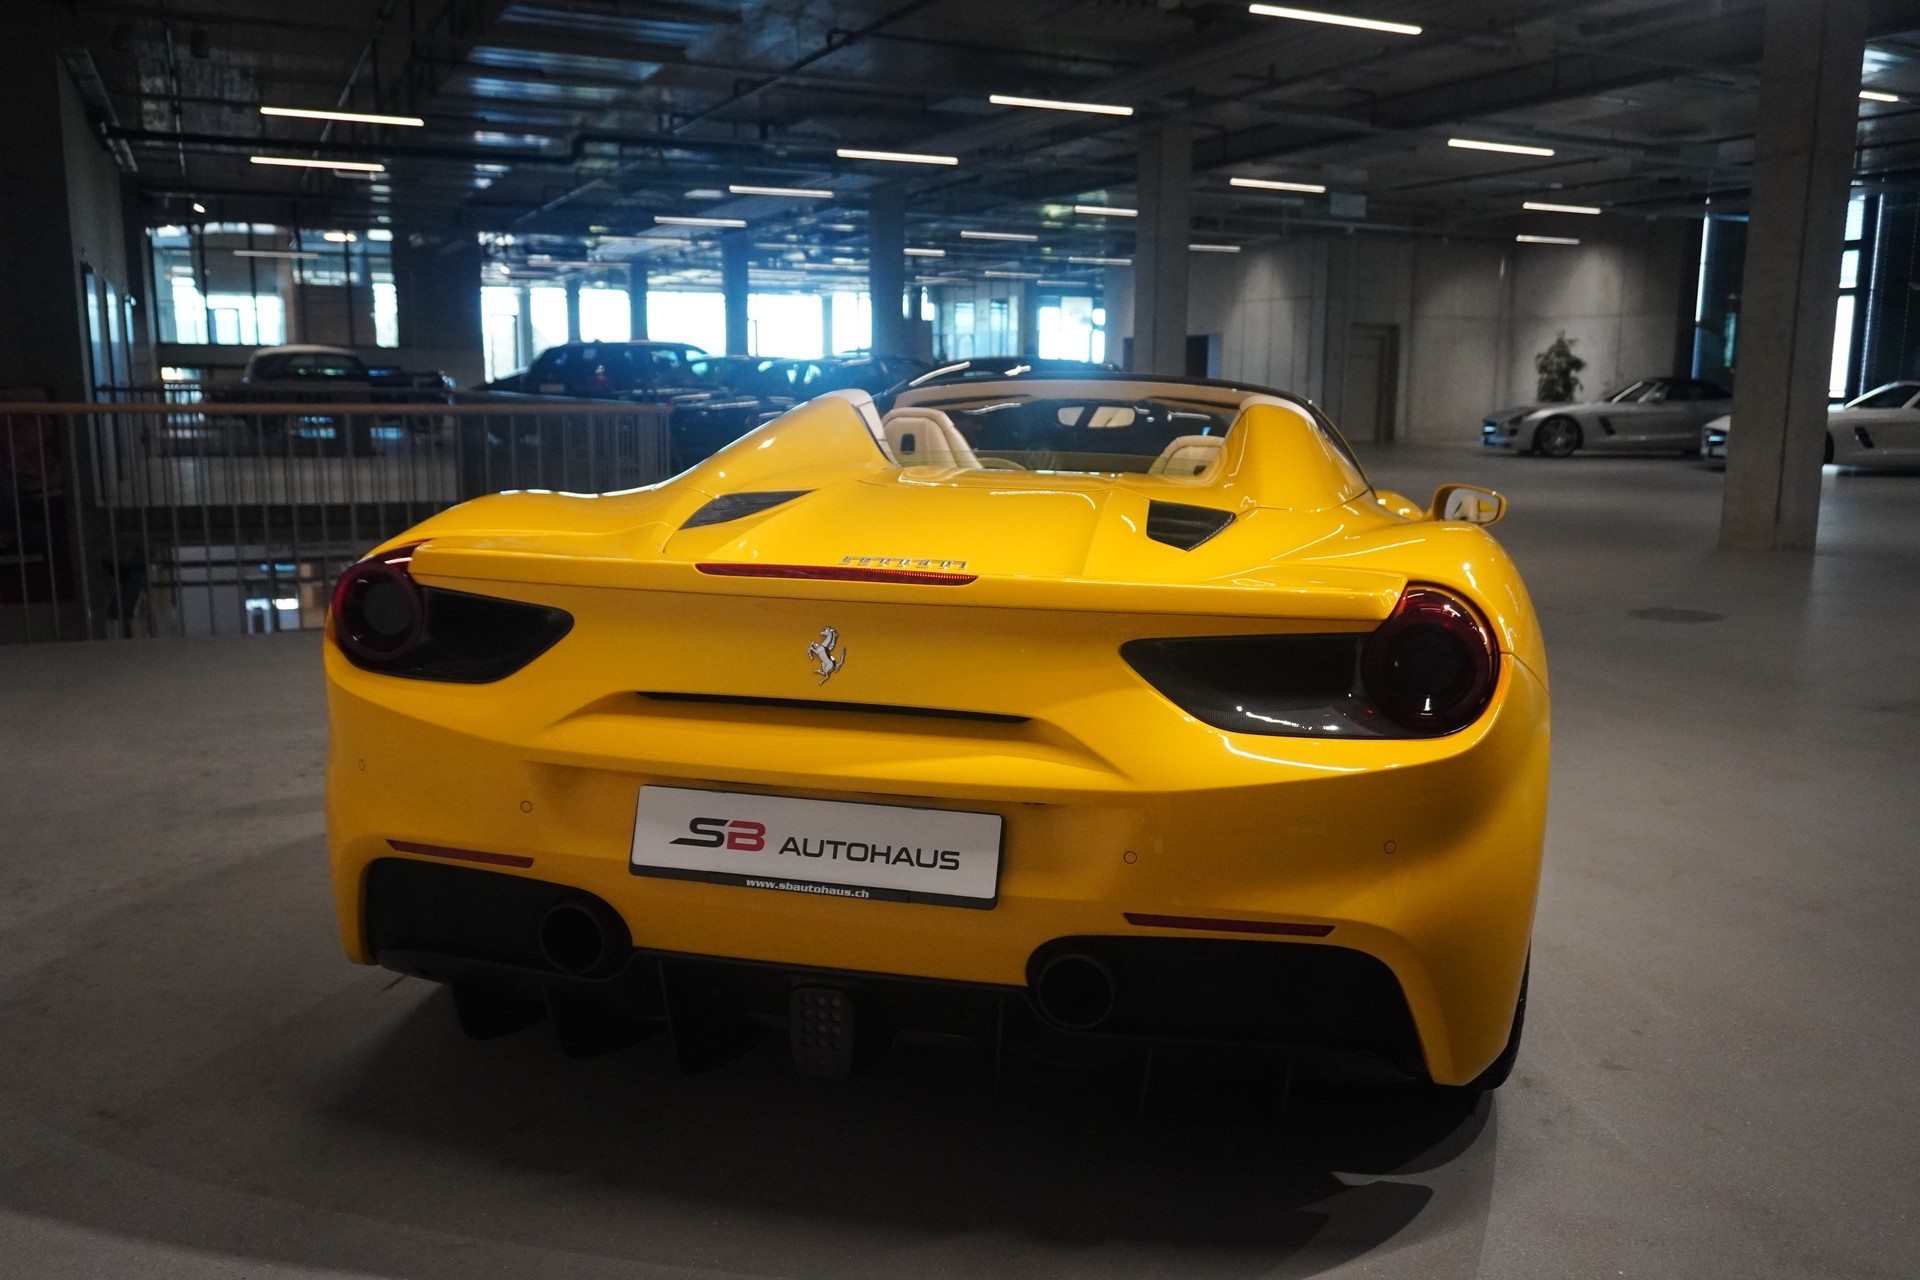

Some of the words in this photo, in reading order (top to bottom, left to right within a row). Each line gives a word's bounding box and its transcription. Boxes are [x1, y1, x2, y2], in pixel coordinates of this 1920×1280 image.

[669, 817, 766, 852] SB
[778, 837, 960, 871] AUTOHAUS
[745, 878, 870, 899] www.sbautohaus.ch
